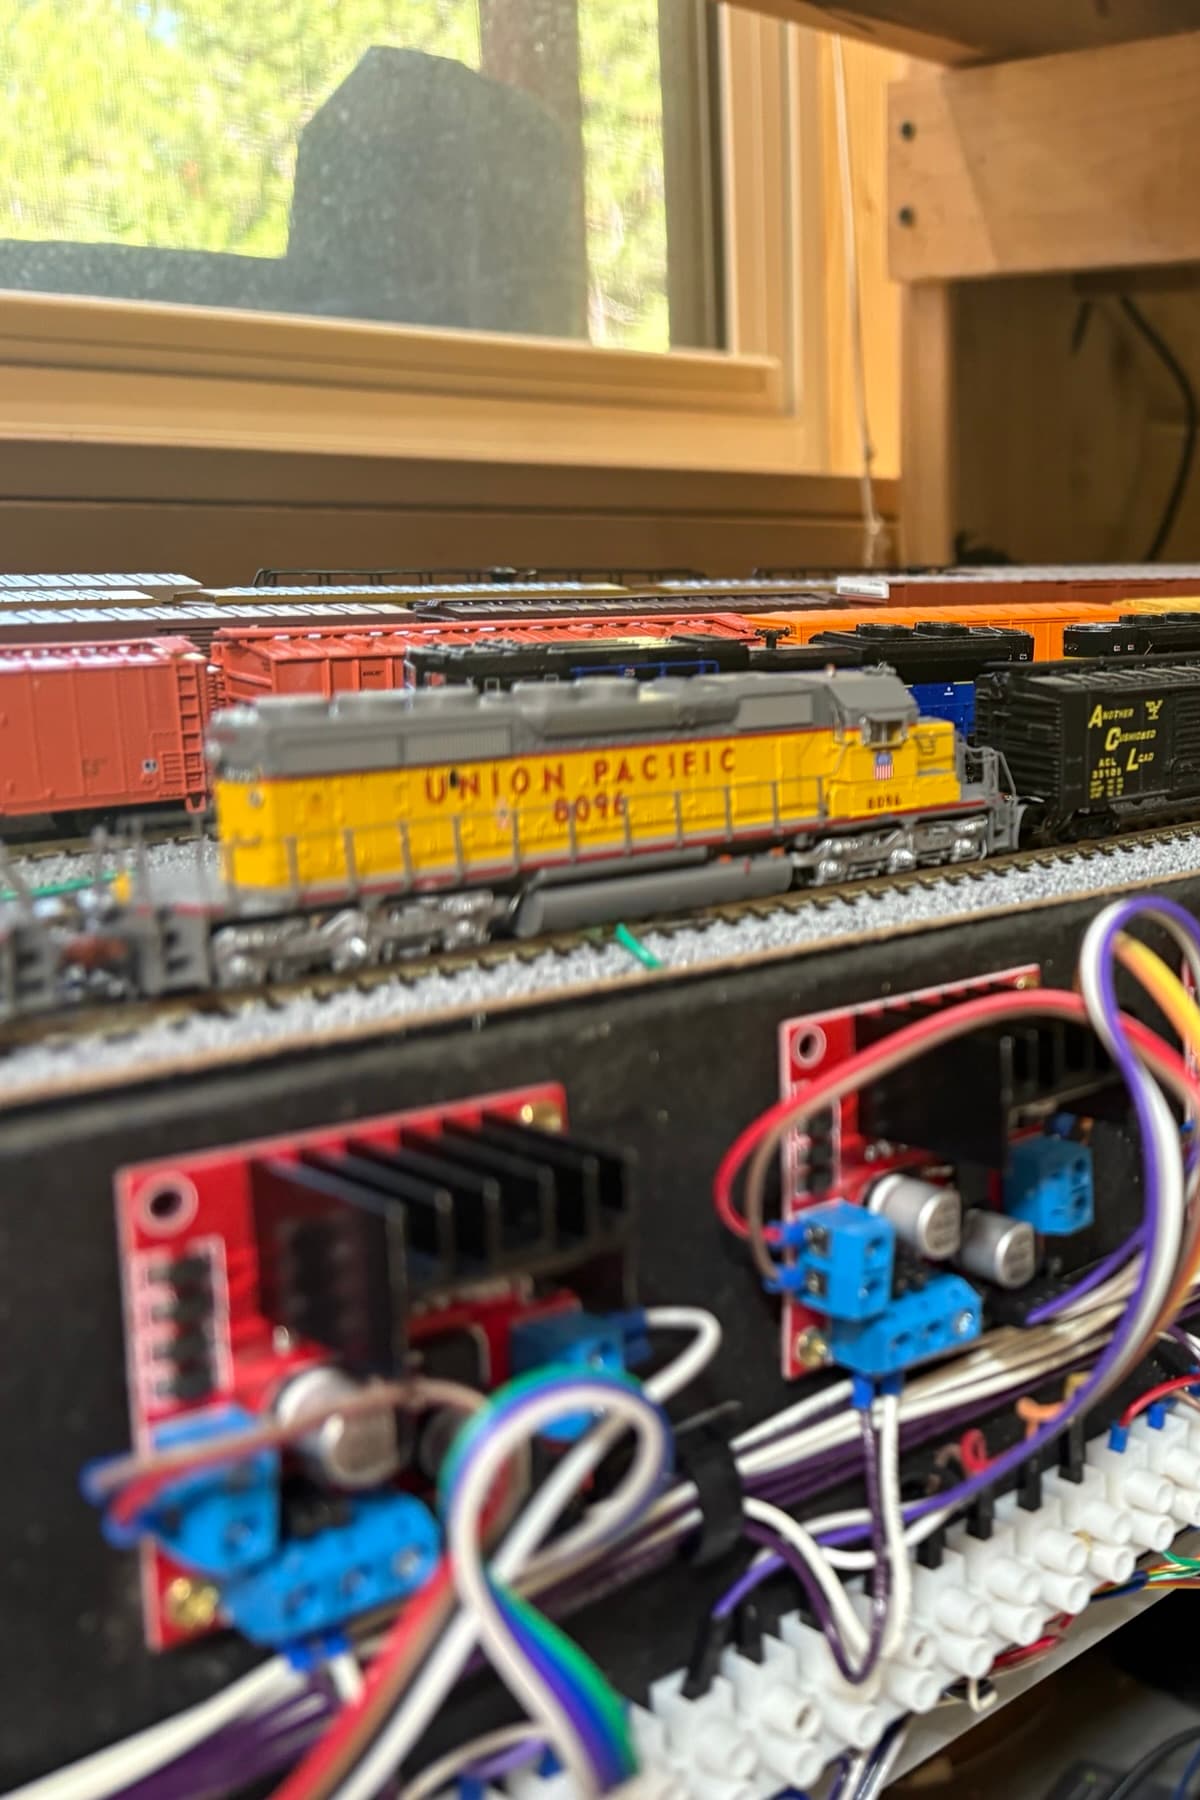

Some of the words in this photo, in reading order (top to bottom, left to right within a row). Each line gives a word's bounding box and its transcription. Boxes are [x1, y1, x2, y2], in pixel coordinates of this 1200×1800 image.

[424, 763, 564, 805] UNION
[593, 748, 736, 786] PACIFIC
[1098, 757, 1117, 768] ACL
[554, 792, 625, 823] 8096
